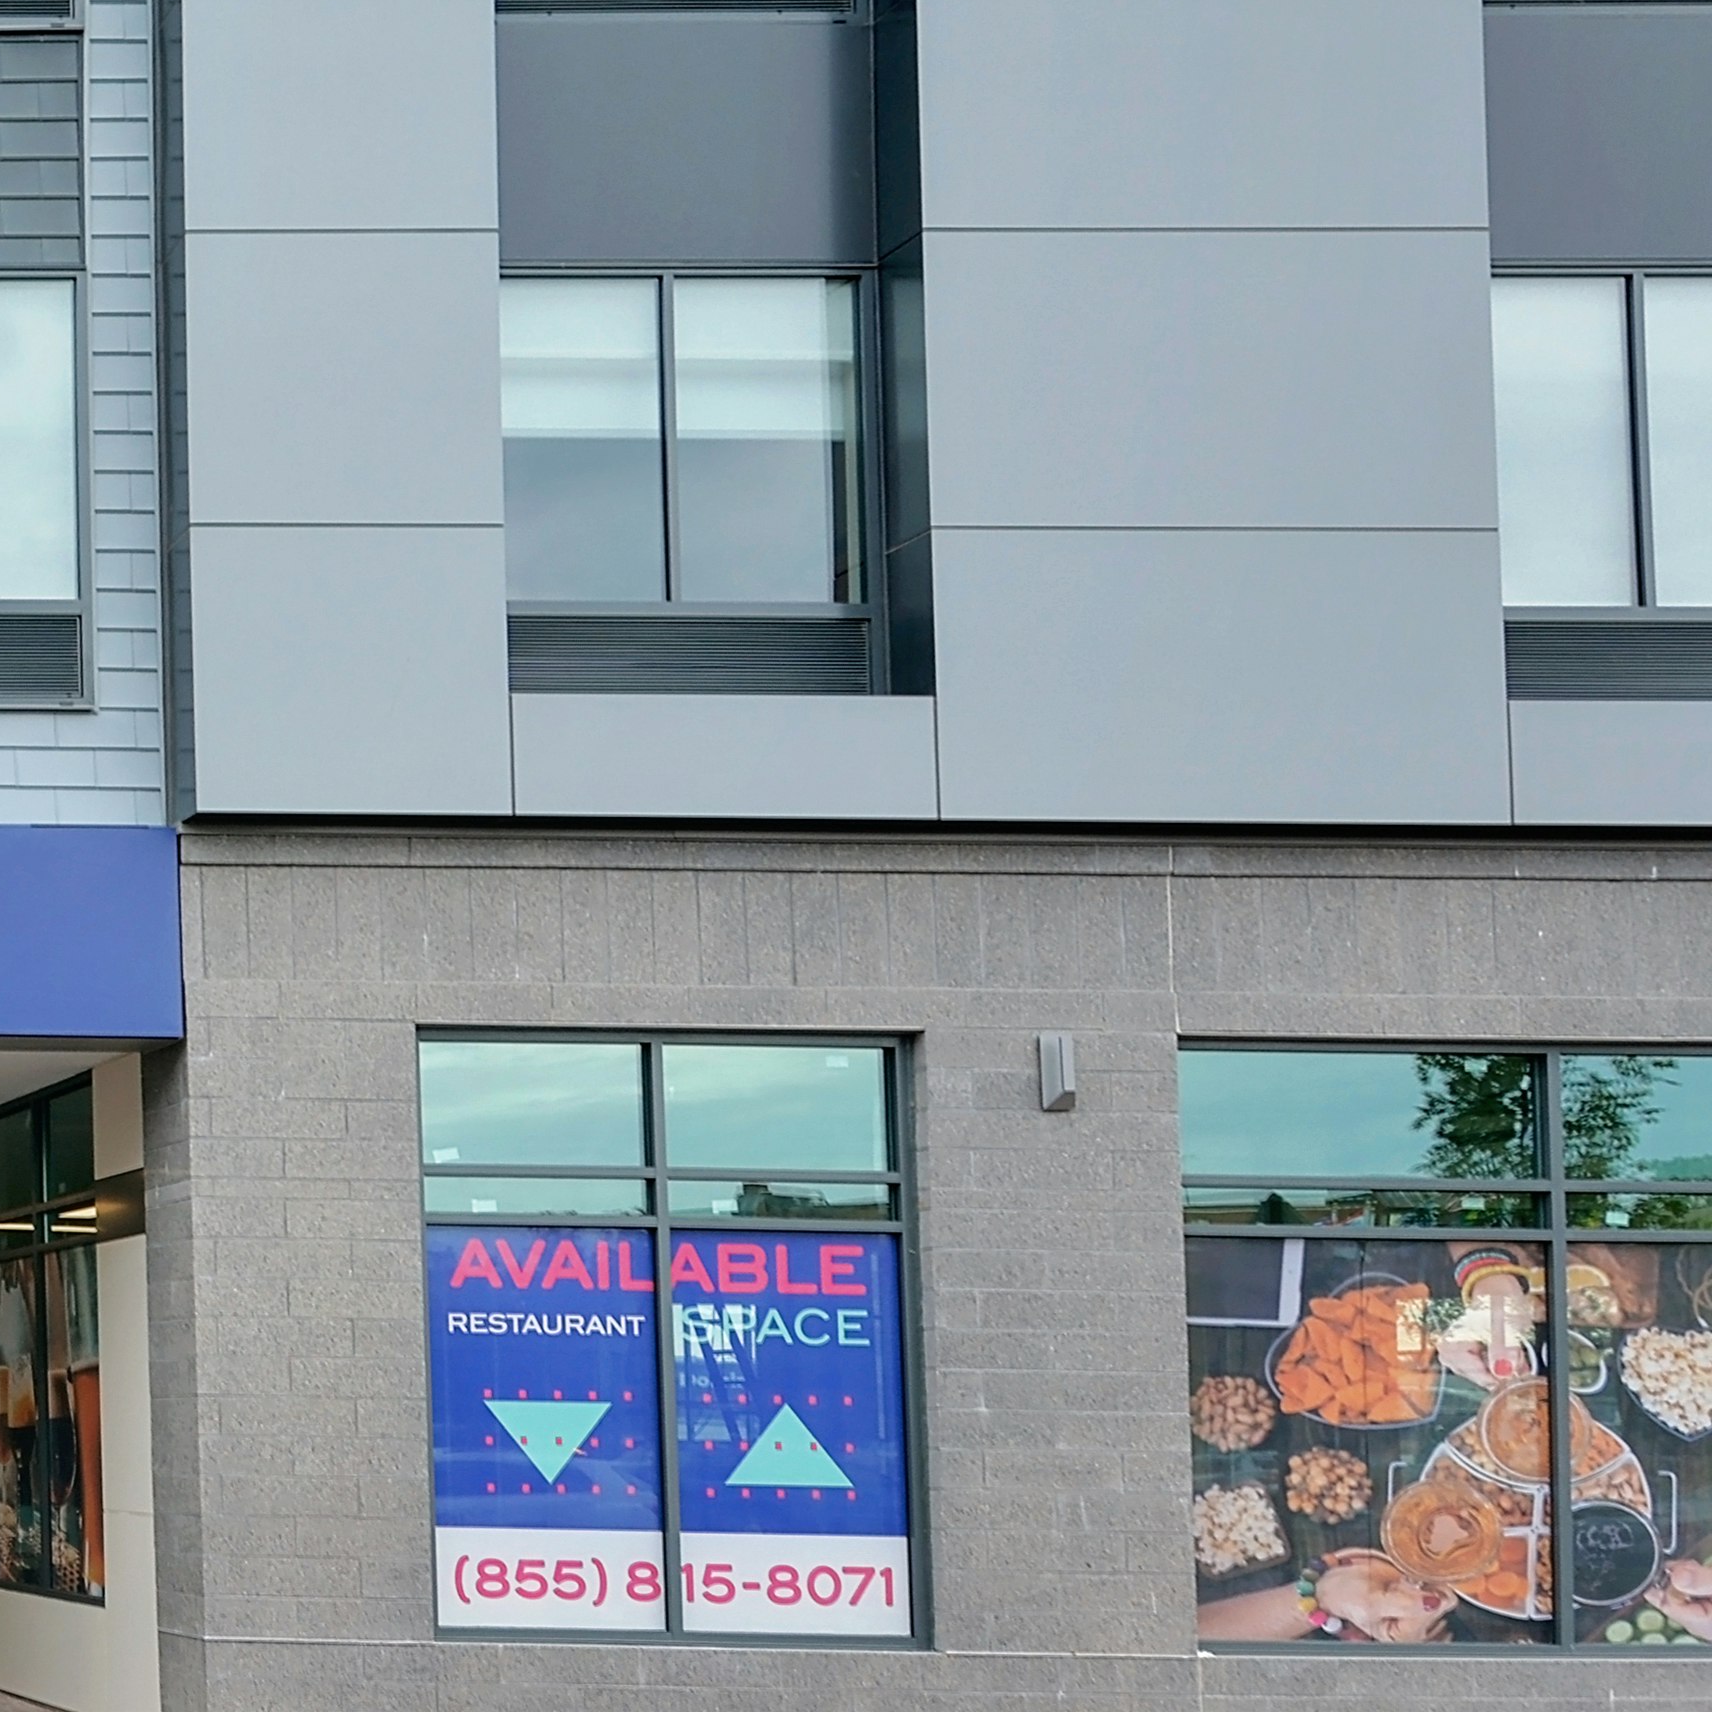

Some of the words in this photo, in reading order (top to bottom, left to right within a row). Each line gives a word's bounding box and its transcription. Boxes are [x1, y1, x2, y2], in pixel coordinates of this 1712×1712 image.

[449, 1237, 867, 1296] AVAILABLE
[447, 1312, 646, 1337] RESTAURANT
[682, 1306, 871, 1347] SPACE
[455, 1554, 608, 1607] (855)
[626, 1560, 894, 1607] 815-8071
